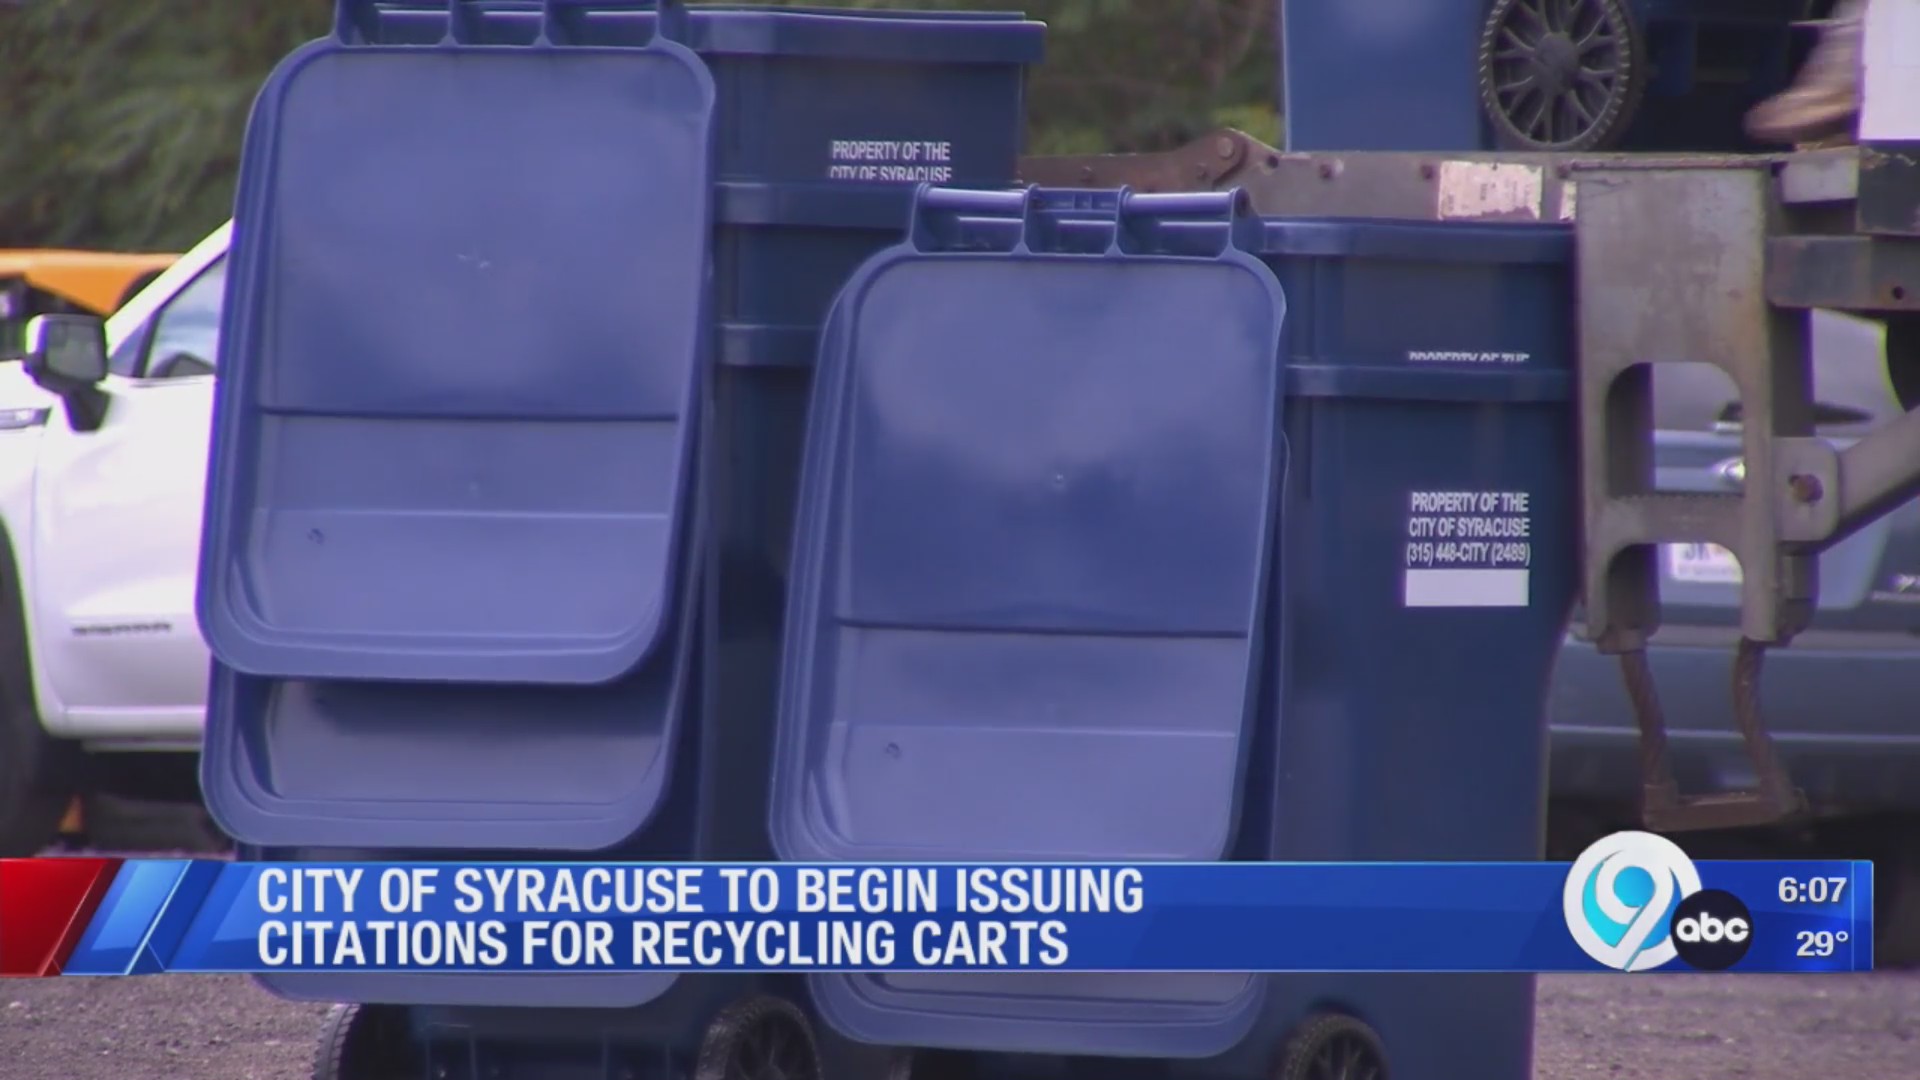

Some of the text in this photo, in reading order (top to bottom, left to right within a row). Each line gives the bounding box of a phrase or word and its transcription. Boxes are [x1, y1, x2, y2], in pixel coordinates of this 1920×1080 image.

[832, 141, 951, 161] PROPERTY OF THE
[830, 165, 858, 179] CITY
[1411, 492, 1530, 512] PROPERTY OF THE
[1409, 517, 1531, 537] CITY OF SYRACUSE
[1406, 541, 1531, 567] (315) 448-CITY (2489)
